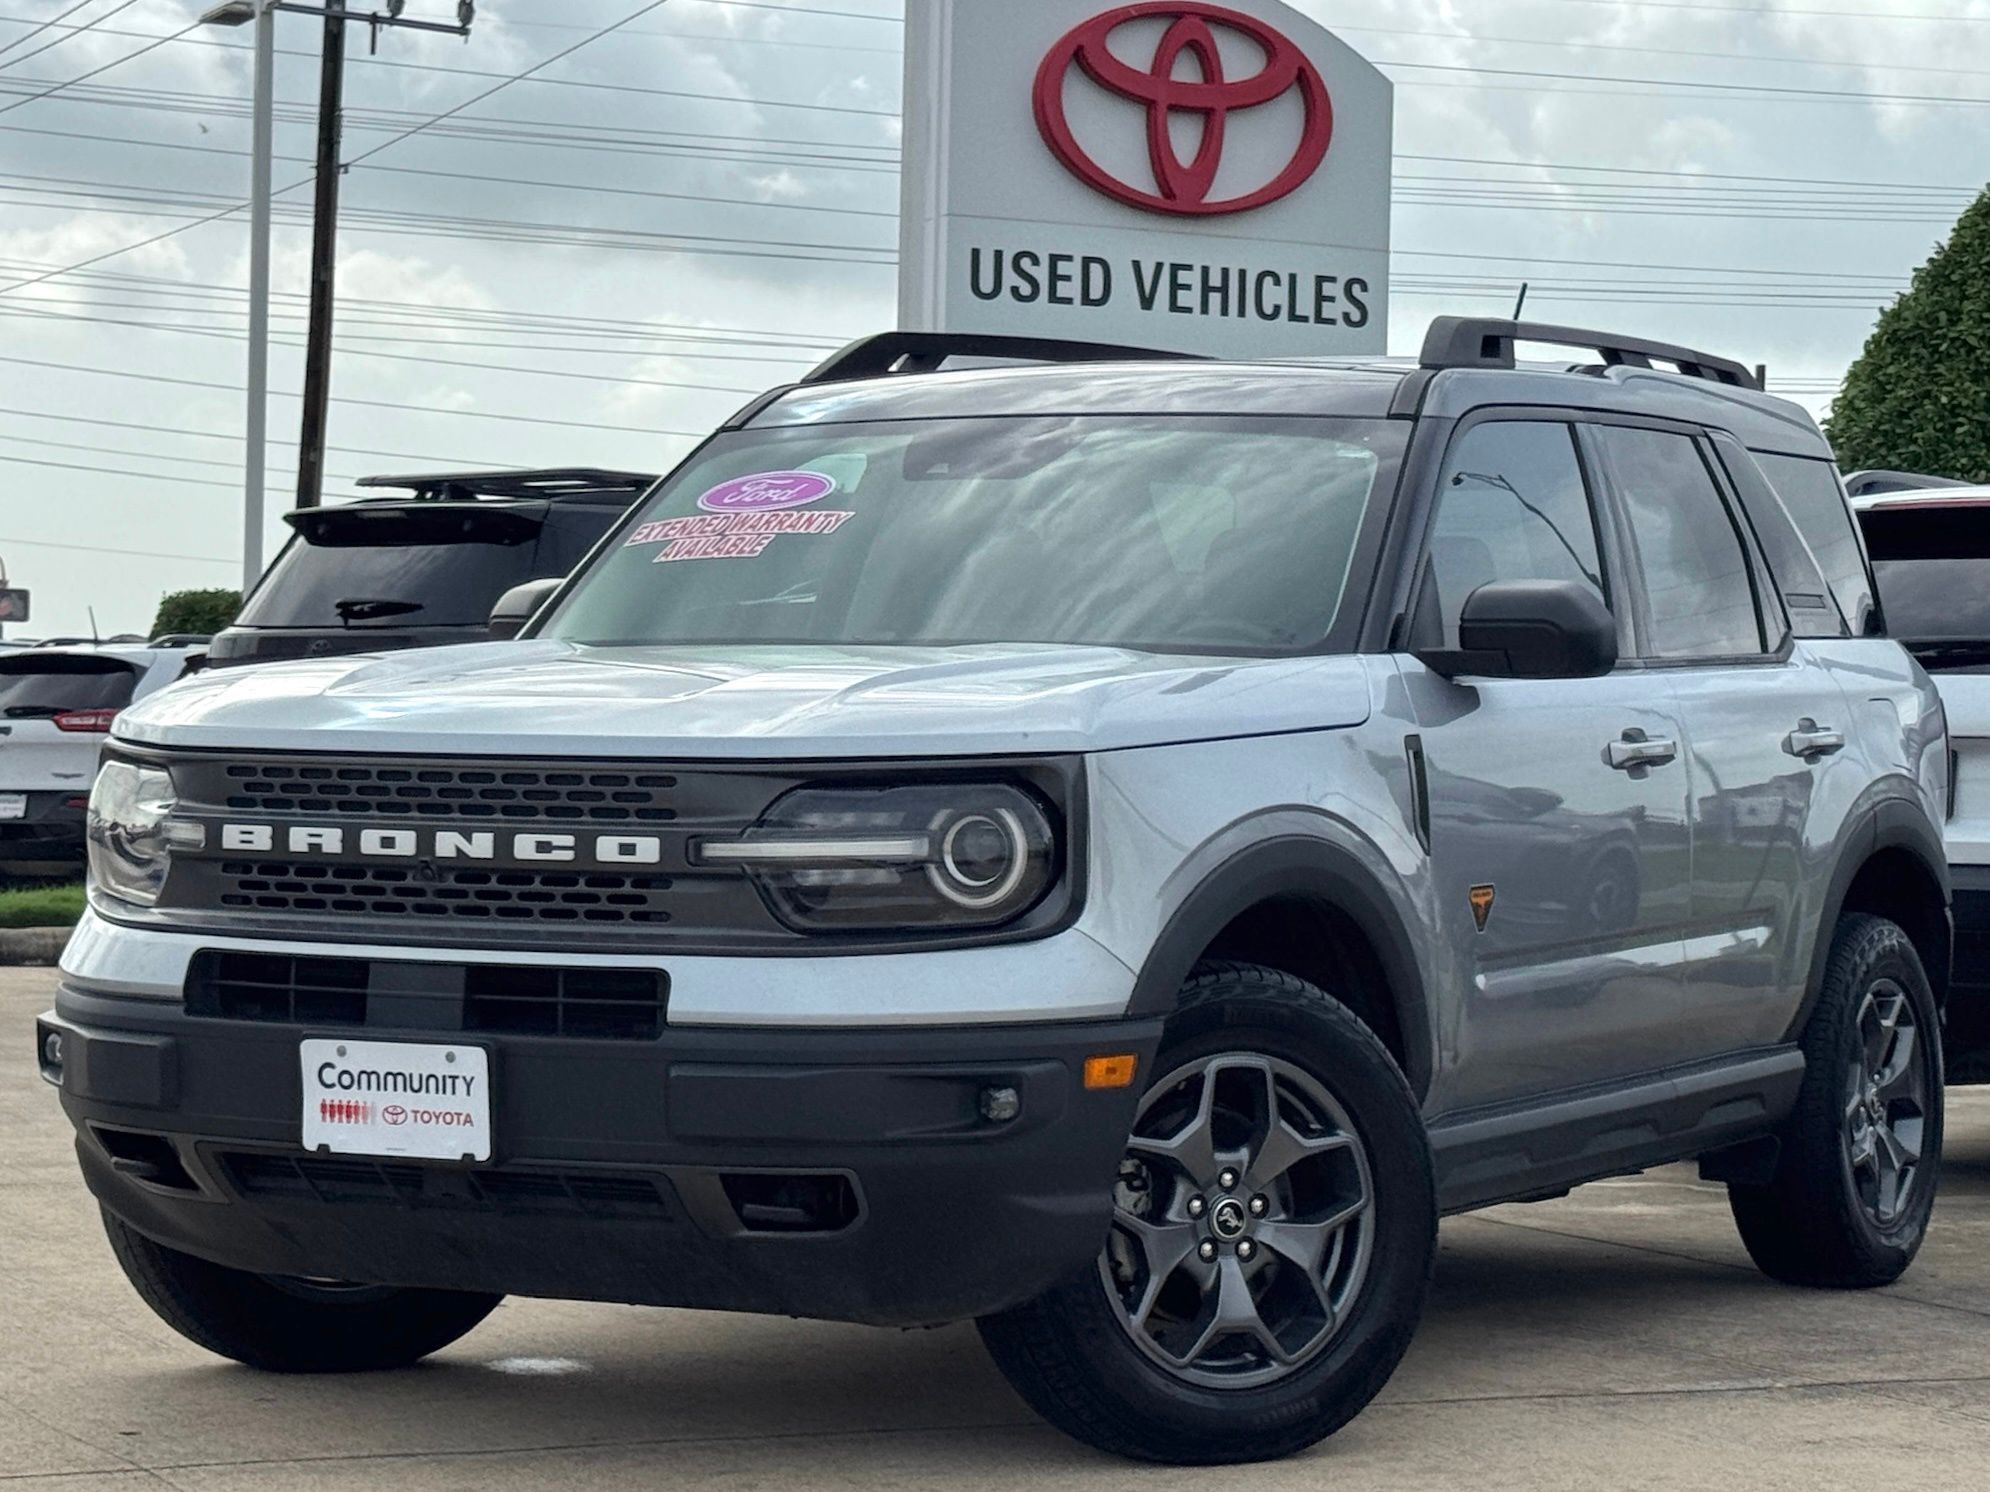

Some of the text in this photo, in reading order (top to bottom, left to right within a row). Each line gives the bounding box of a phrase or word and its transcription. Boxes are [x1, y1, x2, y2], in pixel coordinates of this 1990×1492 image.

[970, 247, 1370, 329] USED VEHICLES
[723, 479, 808, 503] Ford
[631, 512, 850, 544] EXTENDED WARRANTY
[660, 536, 771, 560] AVAILABLE
[222, 823, 661, 864] BRONCO
[411, 1109, 475, 1127] TOYOTA
